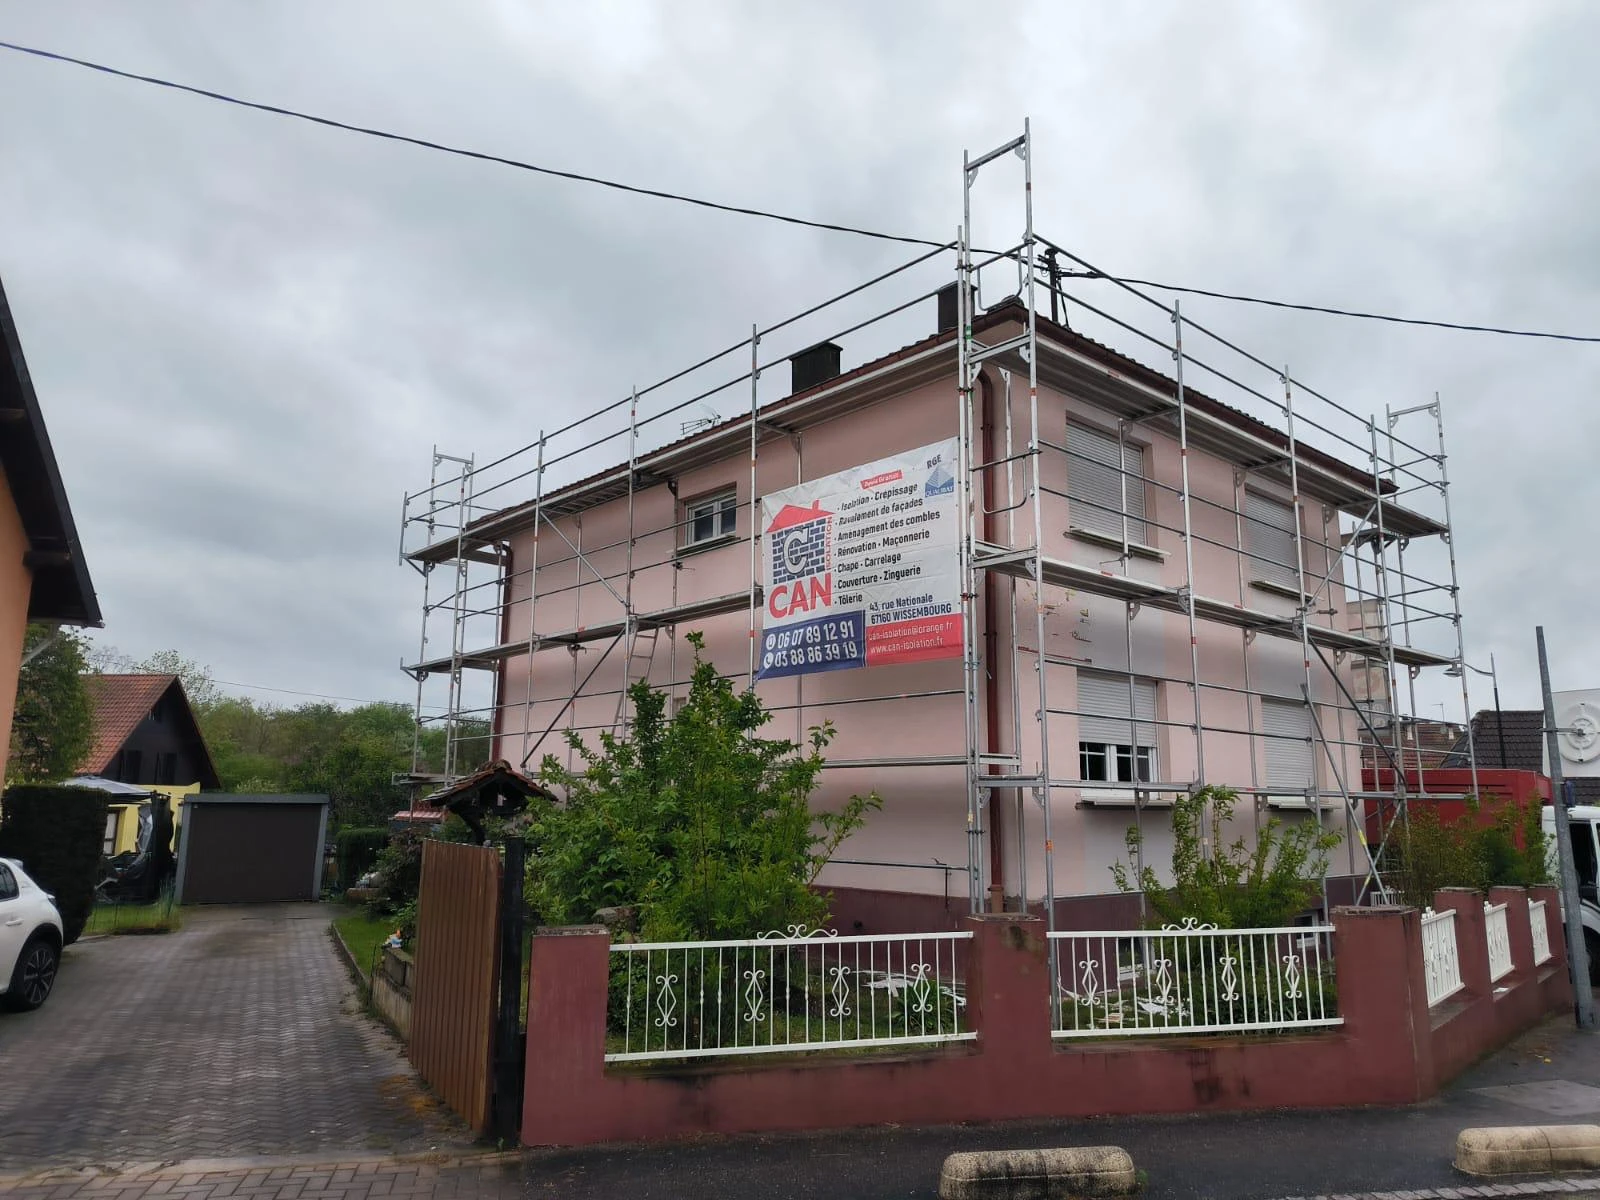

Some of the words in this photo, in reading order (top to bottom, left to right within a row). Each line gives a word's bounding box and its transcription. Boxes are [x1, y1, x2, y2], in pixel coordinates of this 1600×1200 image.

[926, 454, 942, 469] RGE
[838, 509, 879, 526] Ravalement
[880, 505, 890, 514] de
[891, 498, 923, 514] façades
[841, 495, 870, 511] Isolation
[889, 519, 904, 529] des
[905, 510, 941, 526] combles
[825, 516, 833, 571] ISOLATION
[837, 540, 877, 557] Rénovation
[882, 529, 930, 548] Maçonnerie
[837, 561, 859, 573] Chape
[864, 552, 902, 568] Carrelage
[837, 574, 878, 590] Couverture
[883, 564, 921, 582] Zinguerie
[768, 572, 833, 619] CAN
[839, 592, 863, 606] Tôlerie
[881, 600, 895, 611] rue
[895, 593, 934, 608] Nationale
[871, 612, 891, 625] 67160
[892, 602, 952, 621] WISSEMBOURG
[777, 632, 790, 650] 06
[791, 628, 804, 646] 07
[805, 625, 821, 644] 89
[823, 623, 838, 641] 12
[840, 619, 855, 638] 91
[868, 620, 953, 641] can-isolation@orangefr
[774, 650, 788, 668] 03
[790, 648, 805, 666] 88
[807, 645, 823, 664] 86
[824, 642, 841, 661] 39
[842, 640, 858, 658] 19
